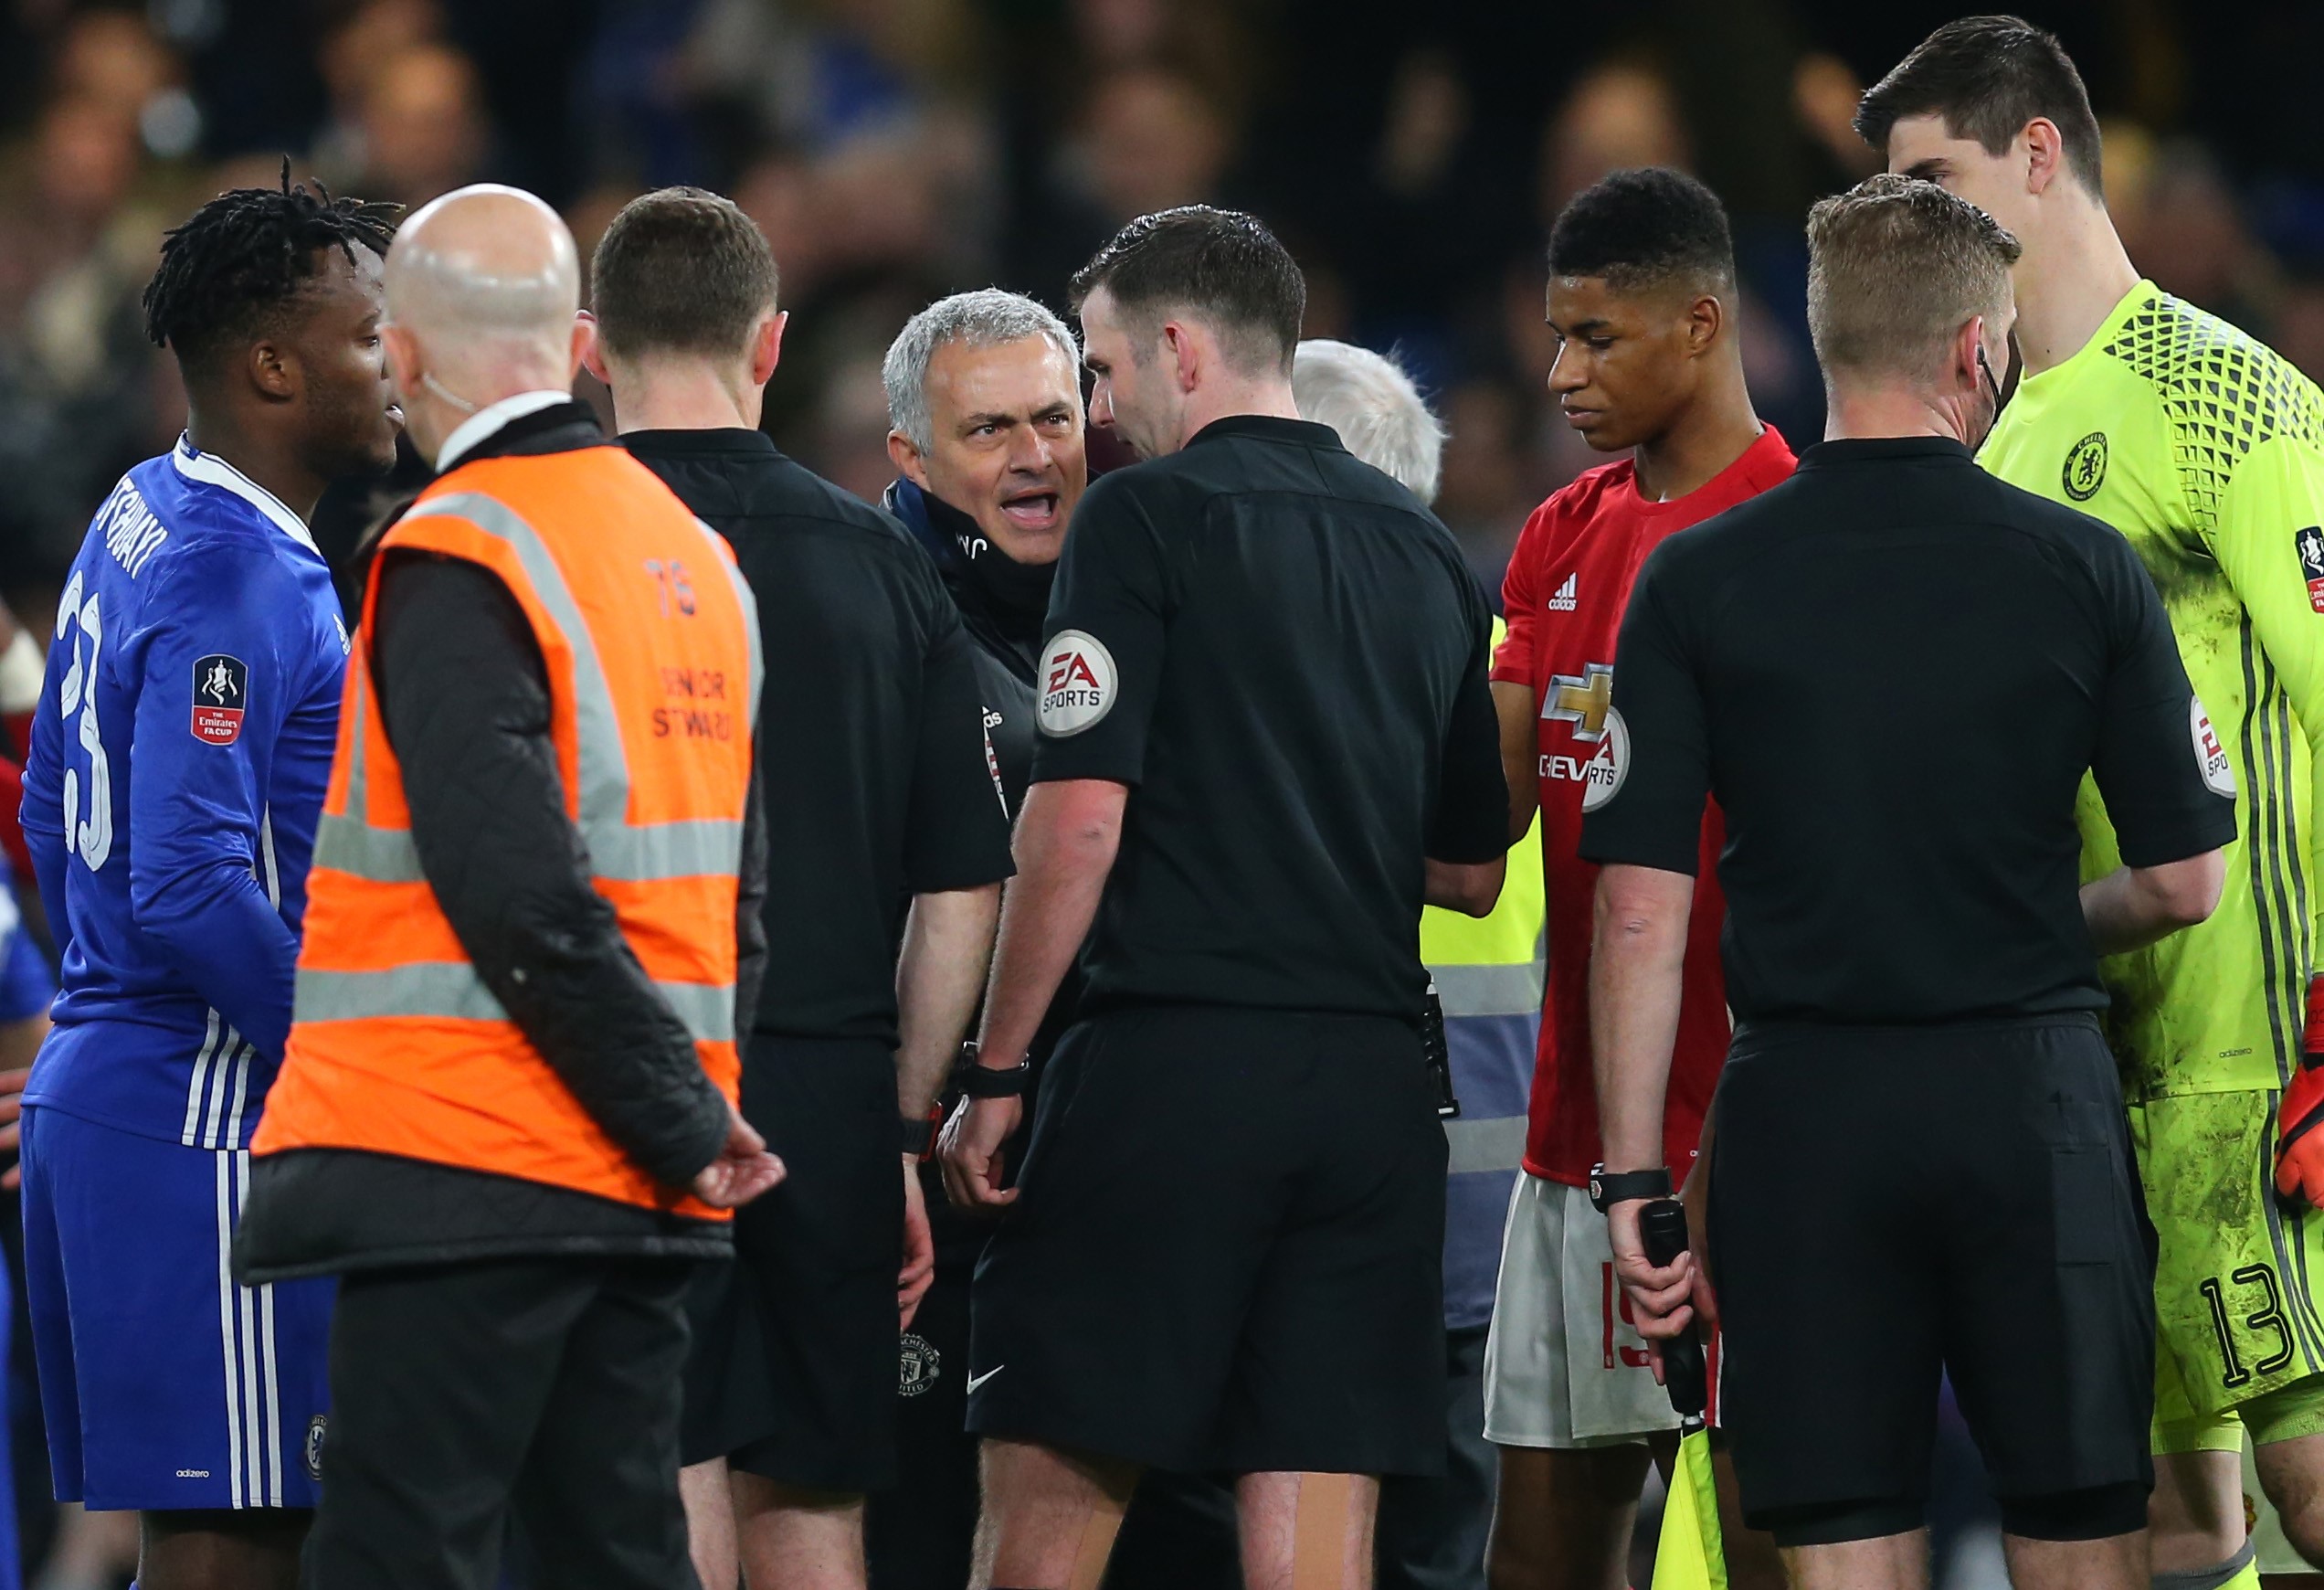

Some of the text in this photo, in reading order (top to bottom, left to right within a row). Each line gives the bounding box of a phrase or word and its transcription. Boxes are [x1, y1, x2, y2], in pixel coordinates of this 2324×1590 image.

[1048, 652, 1101, 694] EA
[1043, 690, 1101, 714] SPORTS
[199, 716, 238, 728] Emirates
[1538, 754, 1592, 782] CHEV
[1588, 766, 1614, 786] RTS
[2208, 754, 2228, 777] SPO
[2201, 1262, 2295, 1387] 13
[901, 1339, 935, 1362] CHESTER
[175, 1468, 210, 1479] adizero
